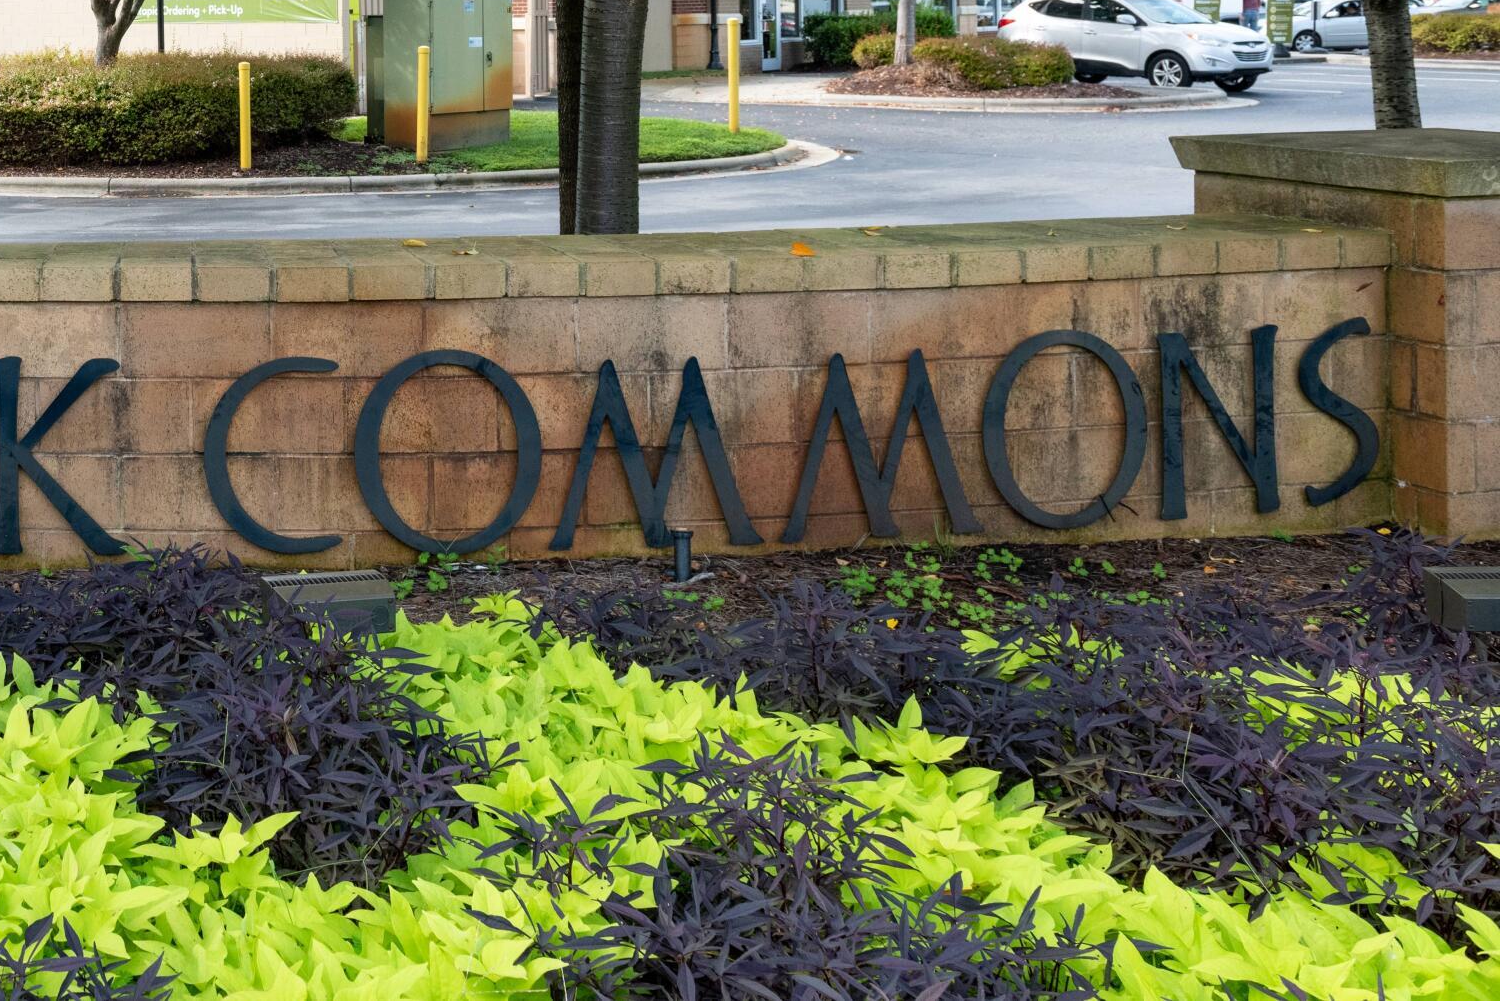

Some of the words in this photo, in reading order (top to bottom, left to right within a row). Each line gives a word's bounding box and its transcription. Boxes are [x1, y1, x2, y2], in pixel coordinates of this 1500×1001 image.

[139, 5, 158, 17] api
[163, 4, 200, 18] Ordering
[208, 3, 244, 18] Pick-Up
[202, 315, 1380, 556] COMMONS
